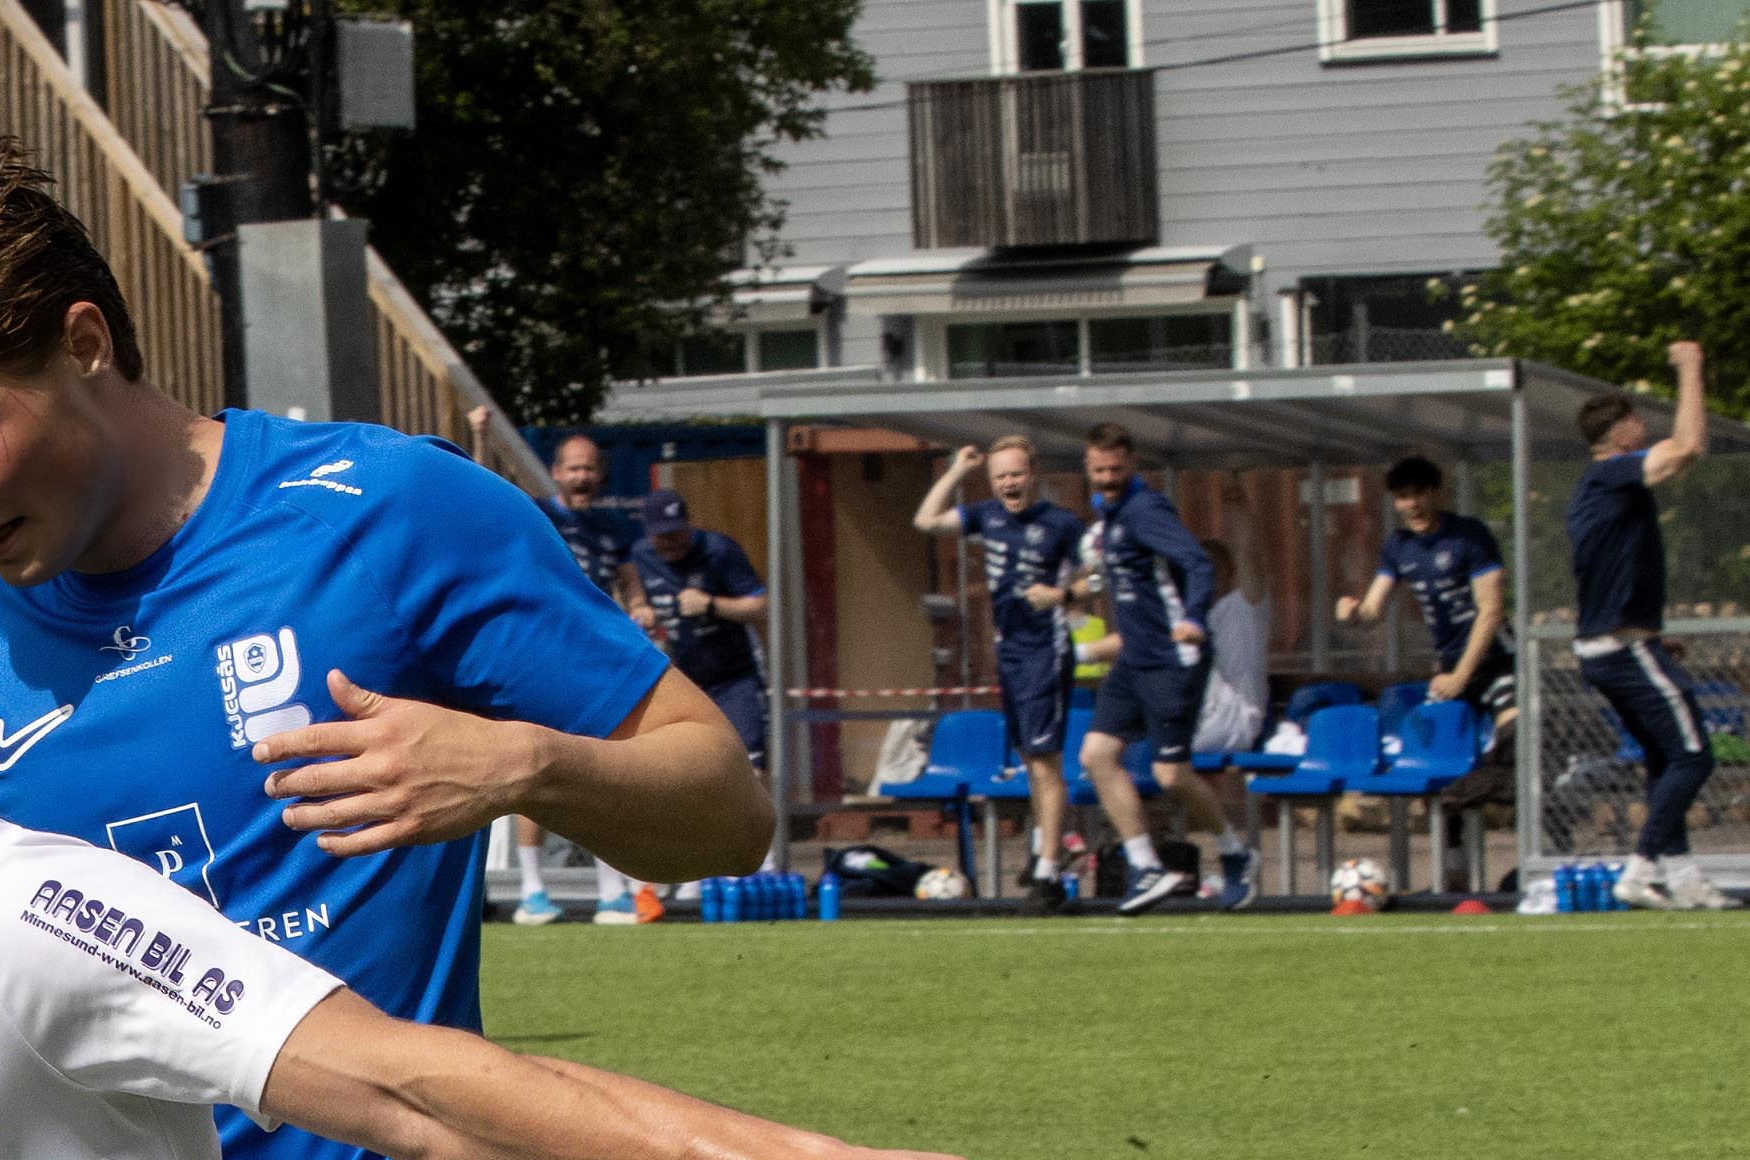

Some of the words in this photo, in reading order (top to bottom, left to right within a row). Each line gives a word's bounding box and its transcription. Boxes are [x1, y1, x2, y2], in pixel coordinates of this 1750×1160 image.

[20, 909, 223, 1030] Minnesund-www.aasen-bil.no
[29, 879, 146, 957] AASEN
[141, 930, 192, 986] BIL
[192, 967, 246, 1016] AS
